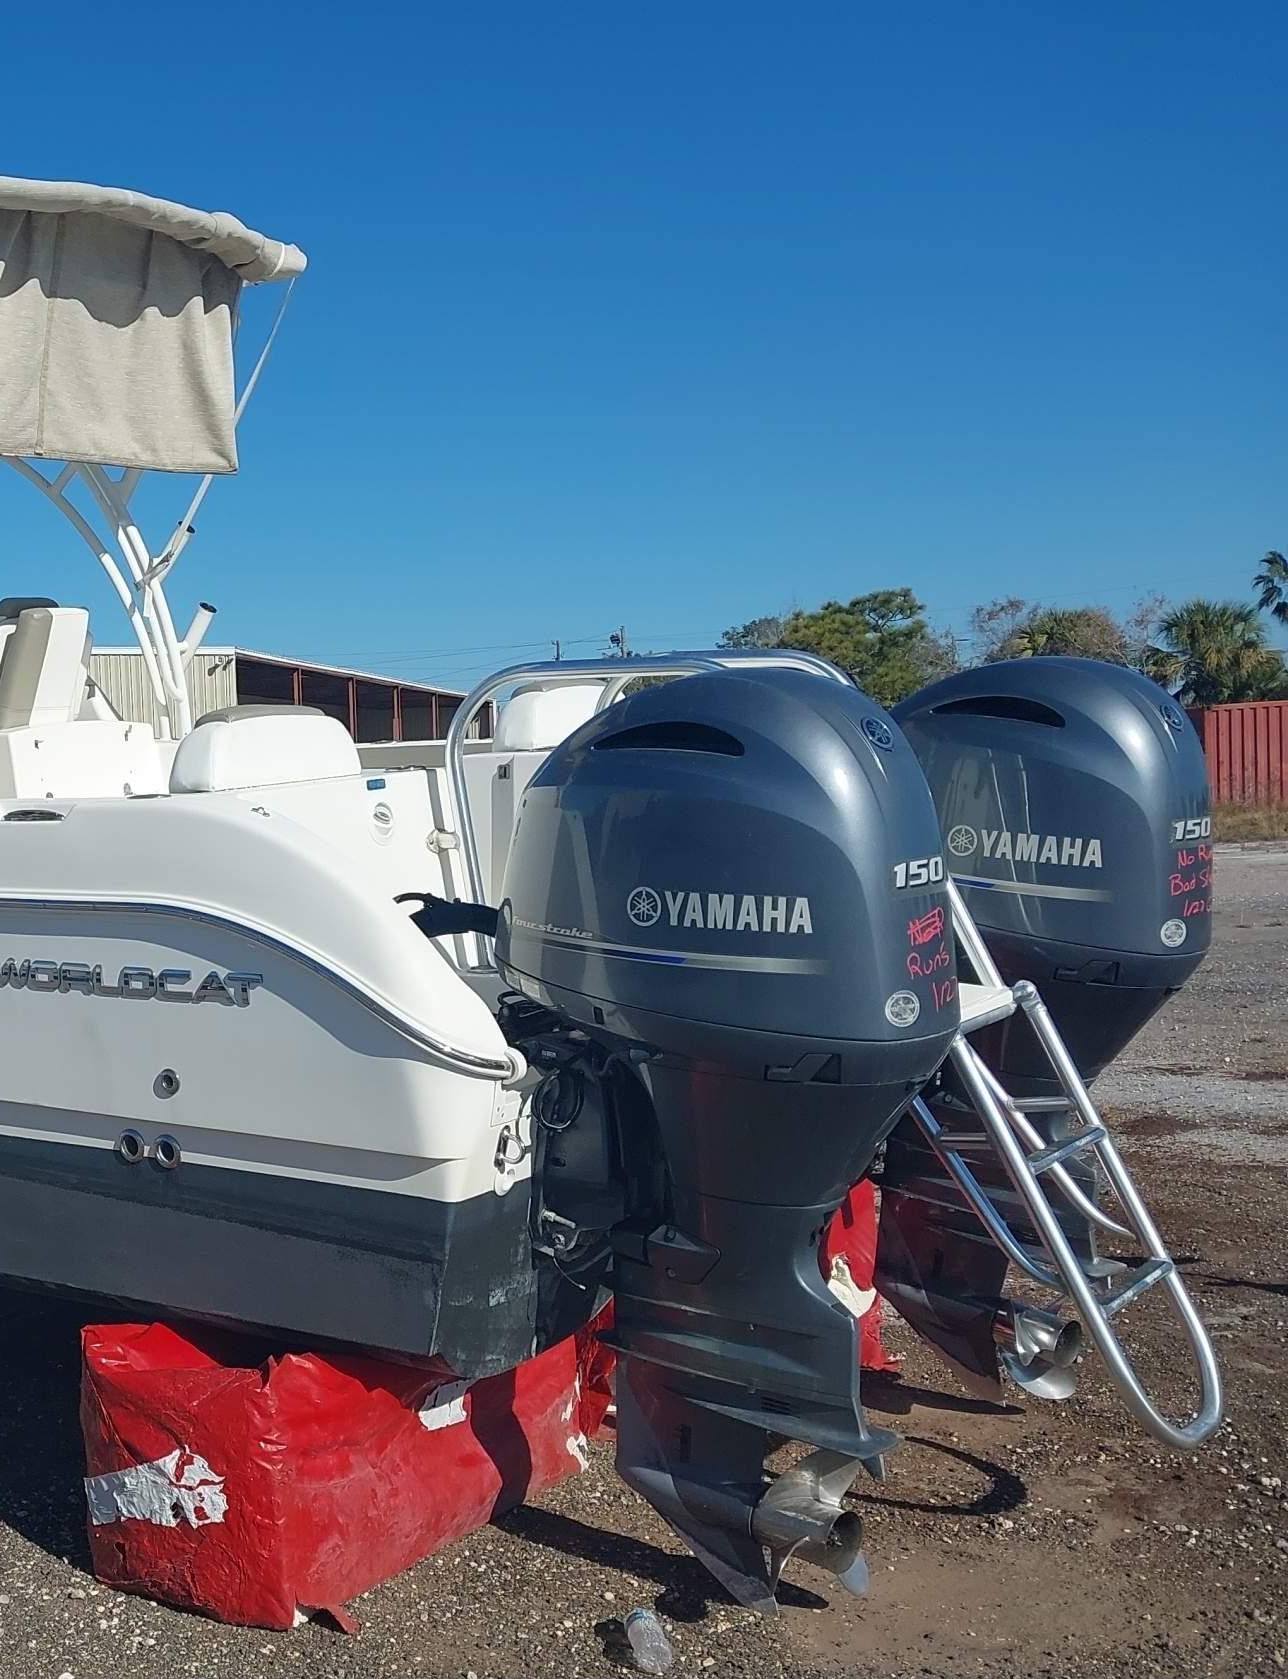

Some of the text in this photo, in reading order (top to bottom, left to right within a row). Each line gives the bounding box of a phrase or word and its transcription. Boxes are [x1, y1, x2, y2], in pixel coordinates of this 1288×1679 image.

[1172, 817, 1211, 840] 150
[981, 829, 1103, 868] YAMAHA
[1177, 849, 1196, 869] No
[893, 856, 944, 889] 150
[664, 890, 813, 934] YAMAHA
